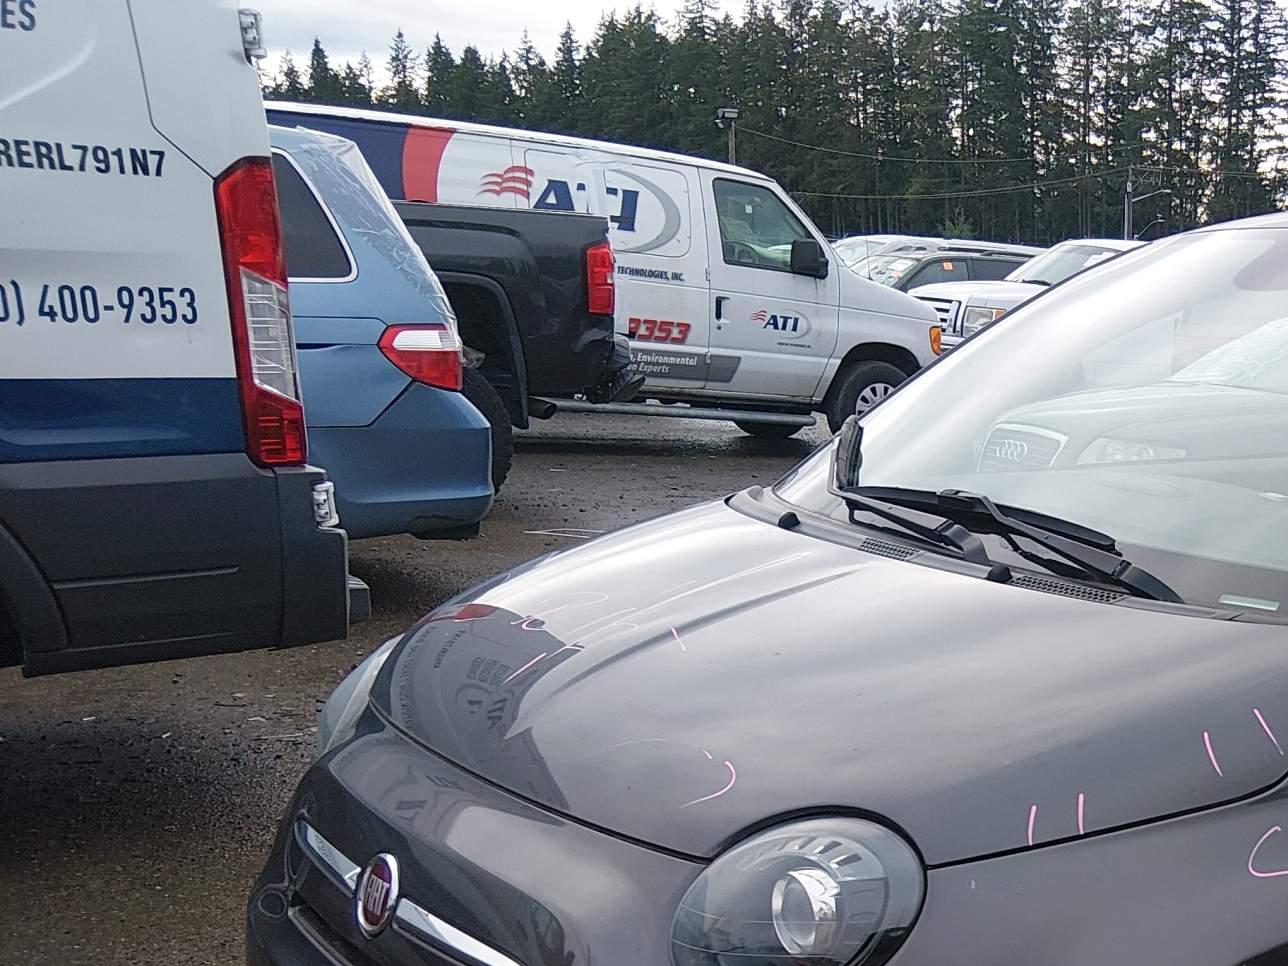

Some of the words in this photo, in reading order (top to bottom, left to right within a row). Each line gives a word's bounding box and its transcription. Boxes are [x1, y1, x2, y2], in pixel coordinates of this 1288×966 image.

[1, 0, 36, 31] ES
[617, 265, 669, 280] TECHNOLOGIES,
[38, 284, 198, 325] 400-9353
[763, 314, 799, 332] ATI
[637, 353, 698, 366] Environmental
[638, 362, 670, 374] Experts
[365, 874, 389, 916] FIAT
